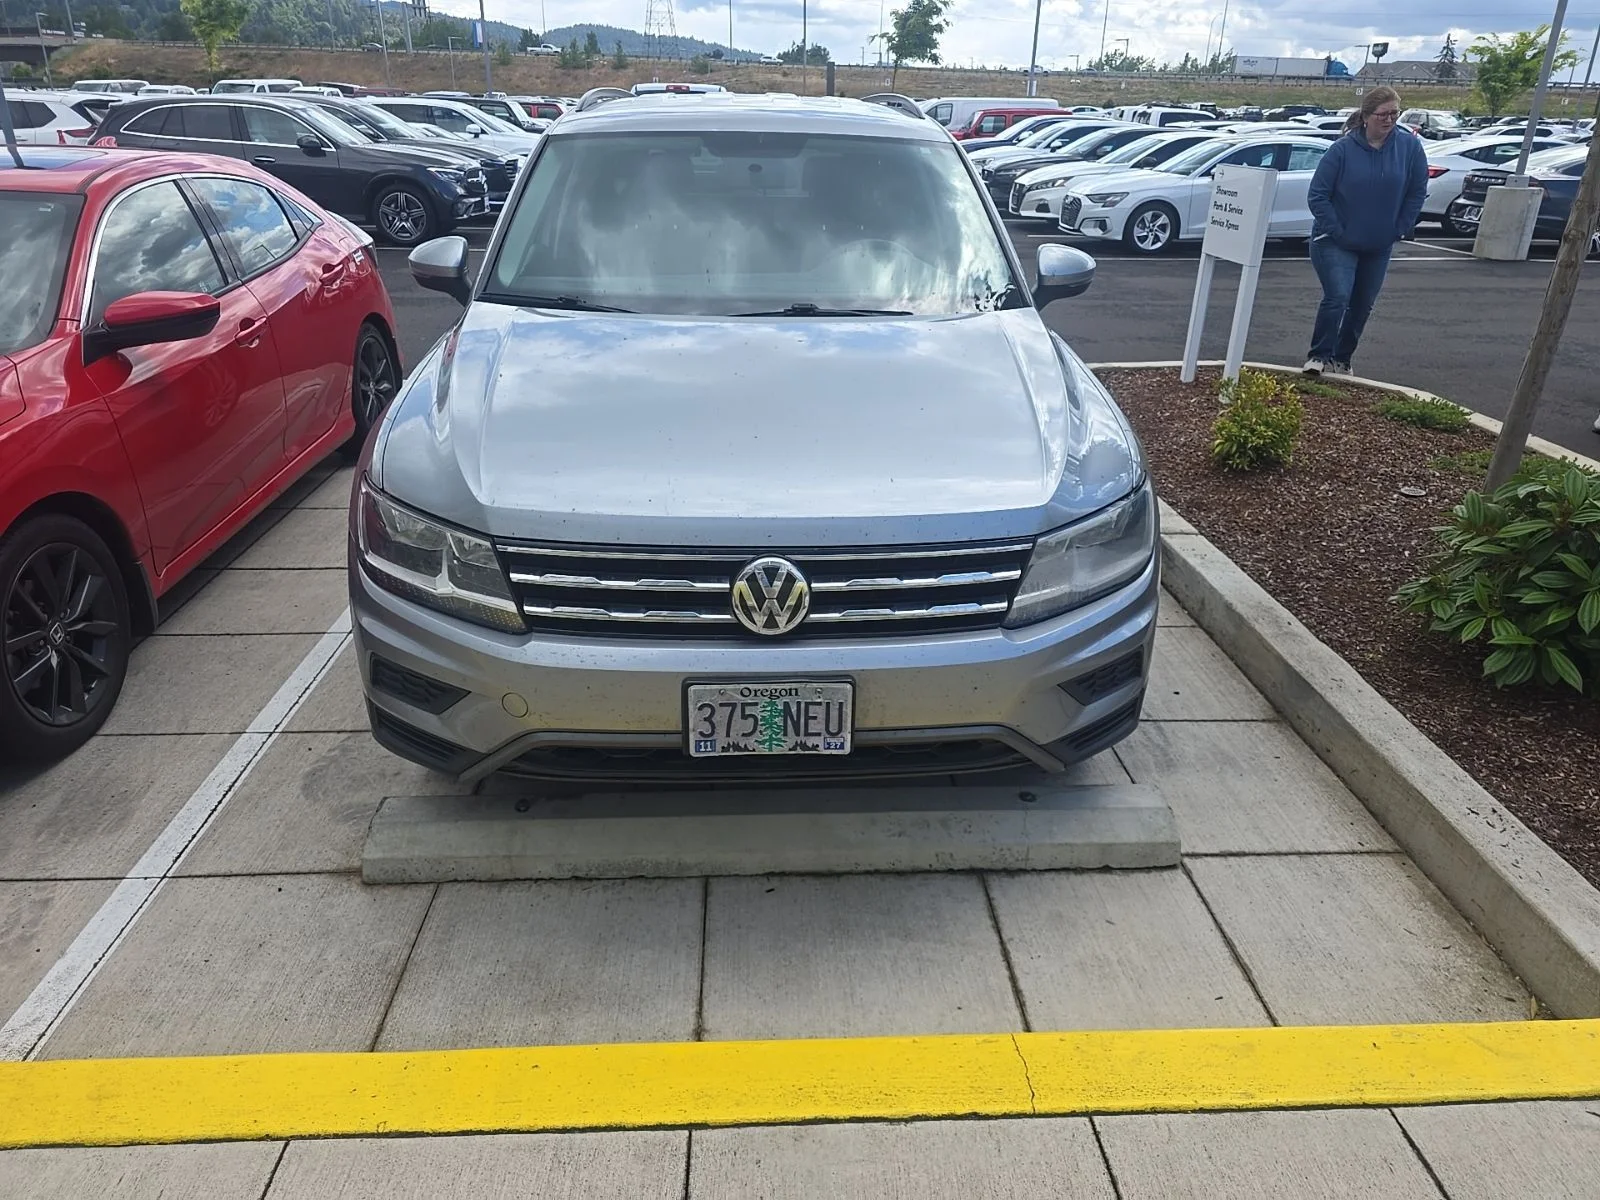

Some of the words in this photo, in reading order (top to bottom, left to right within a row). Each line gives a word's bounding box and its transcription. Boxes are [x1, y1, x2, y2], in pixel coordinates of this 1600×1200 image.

[1216, 186, 1238, 197] Showroom
[1214, 201, 1223, 211] Parts
[1228, 203, 1243, 215] Service
[1211, 216, 1224, 227] Service
[1225, 219, 1239, 230] Xpress
[733, 557, 810, 635] VW
[739, 686, 799, 700] Oregon
[697, 701, 759, 739] 375
[782, 701, 845, 738] NEU
[699, 741, 712, 752] 11
